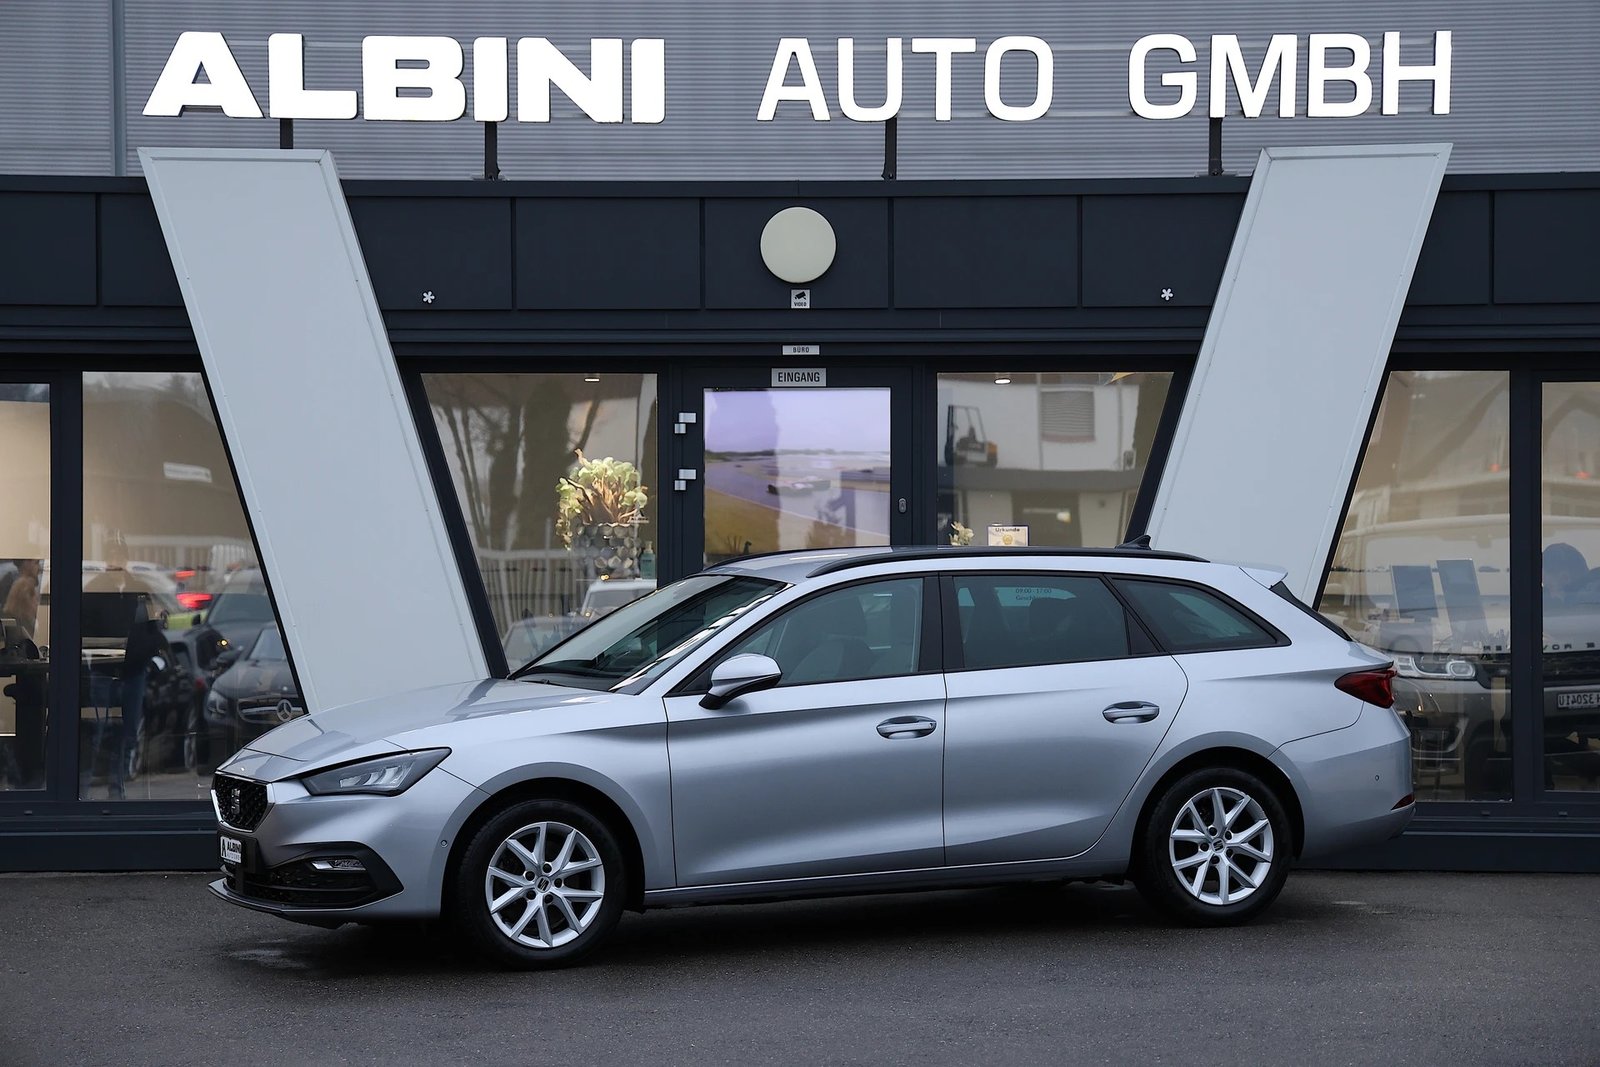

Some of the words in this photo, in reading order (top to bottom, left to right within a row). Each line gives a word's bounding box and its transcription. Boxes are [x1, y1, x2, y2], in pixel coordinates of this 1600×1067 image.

[142, 31, 665, 124] ALBINI
[756, 36, 1054, 122] AUTO
[1128, 30, 1452, 120] GMBH
[778, 372, 820, 383] EINGANG
